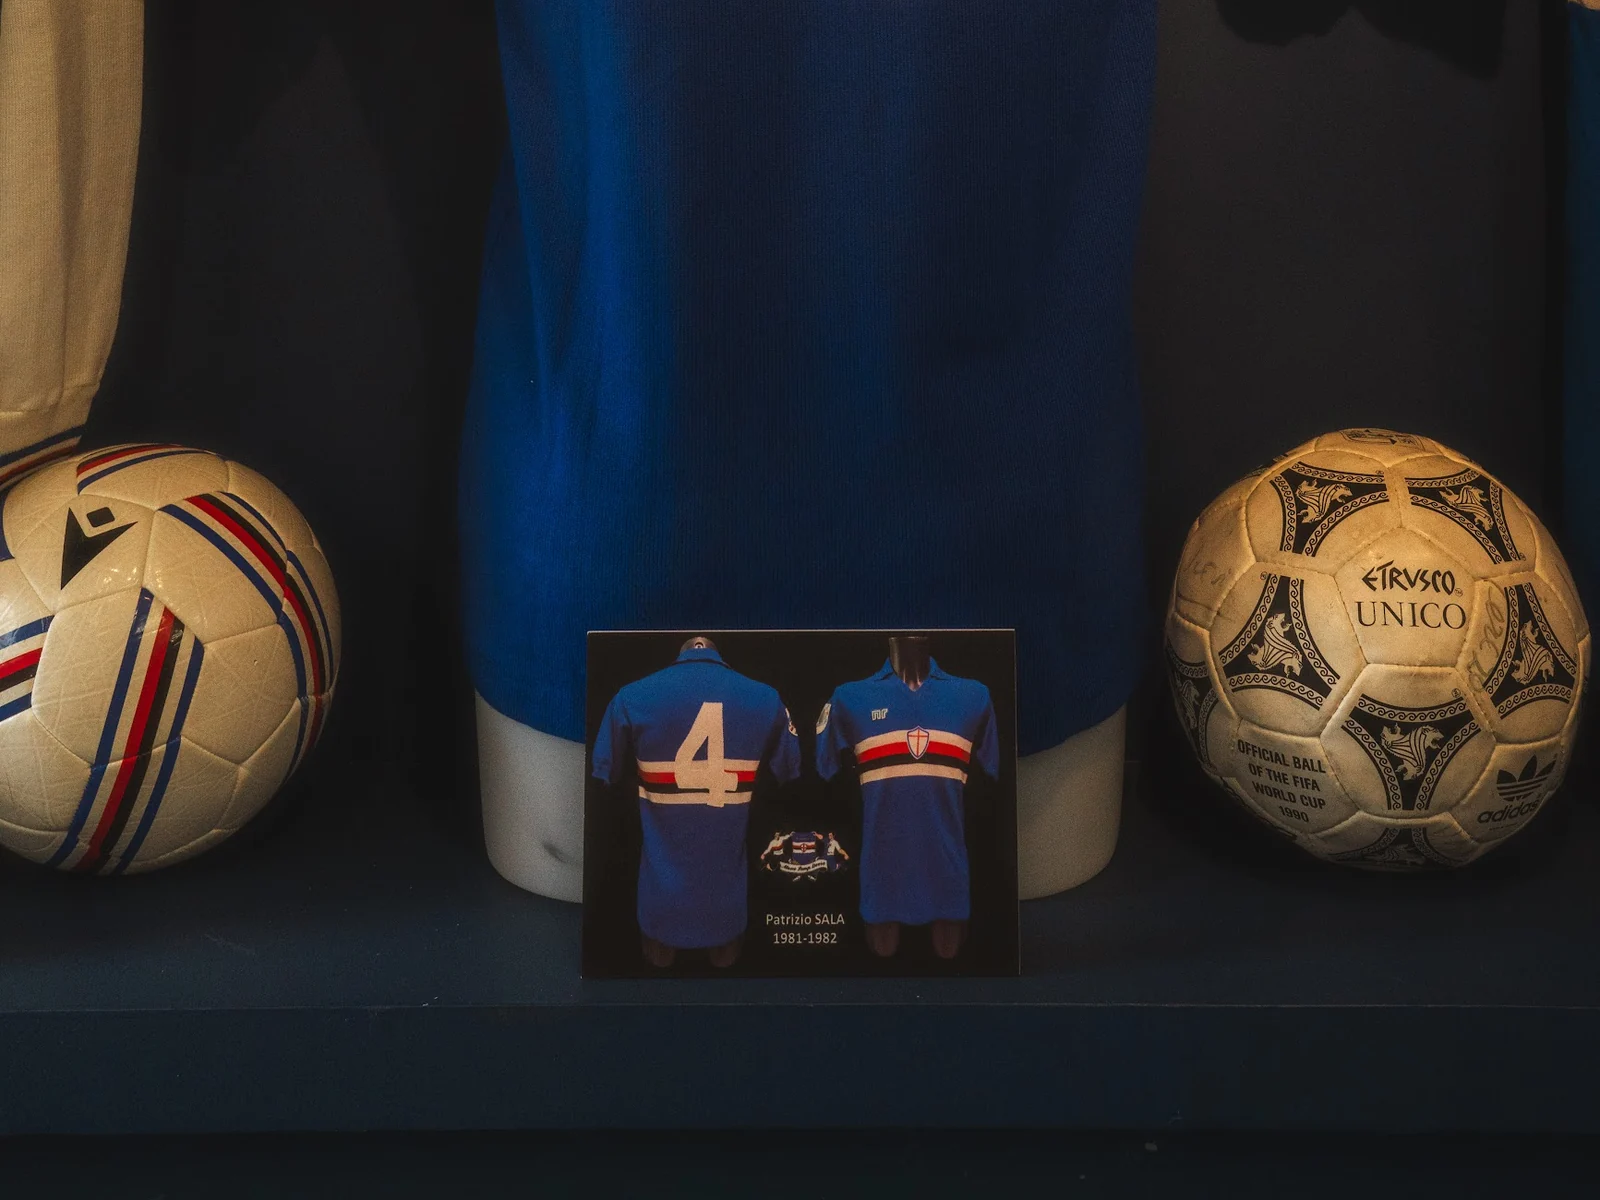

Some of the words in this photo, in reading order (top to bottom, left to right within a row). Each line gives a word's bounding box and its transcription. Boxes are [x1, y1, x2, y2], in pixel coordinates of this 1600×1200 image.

[1355, 601, 1467, 630] UNICO
[674, 701, 739, 808] 4
[1237, 738, 1290, 767] OFFICIAL
[1292, 755, 1327, 774] BALL
[1248, 762, 1263, 778] OF
[1265, 767, 1290, 786] THE
[1292, 774, 1321, 792] FIFA
[1251, 780, 1297, 804] WORLD
[1300, 794, 1326, 810] CUP
[1278, 805, 1309, 823] 1990
[1477, 800, 1539, 824] adidas
[765, 913, 812, 926] Patrizio
[814, 913, 846, 925] SALA
[773, 932, 838, 945] 1981-1982
